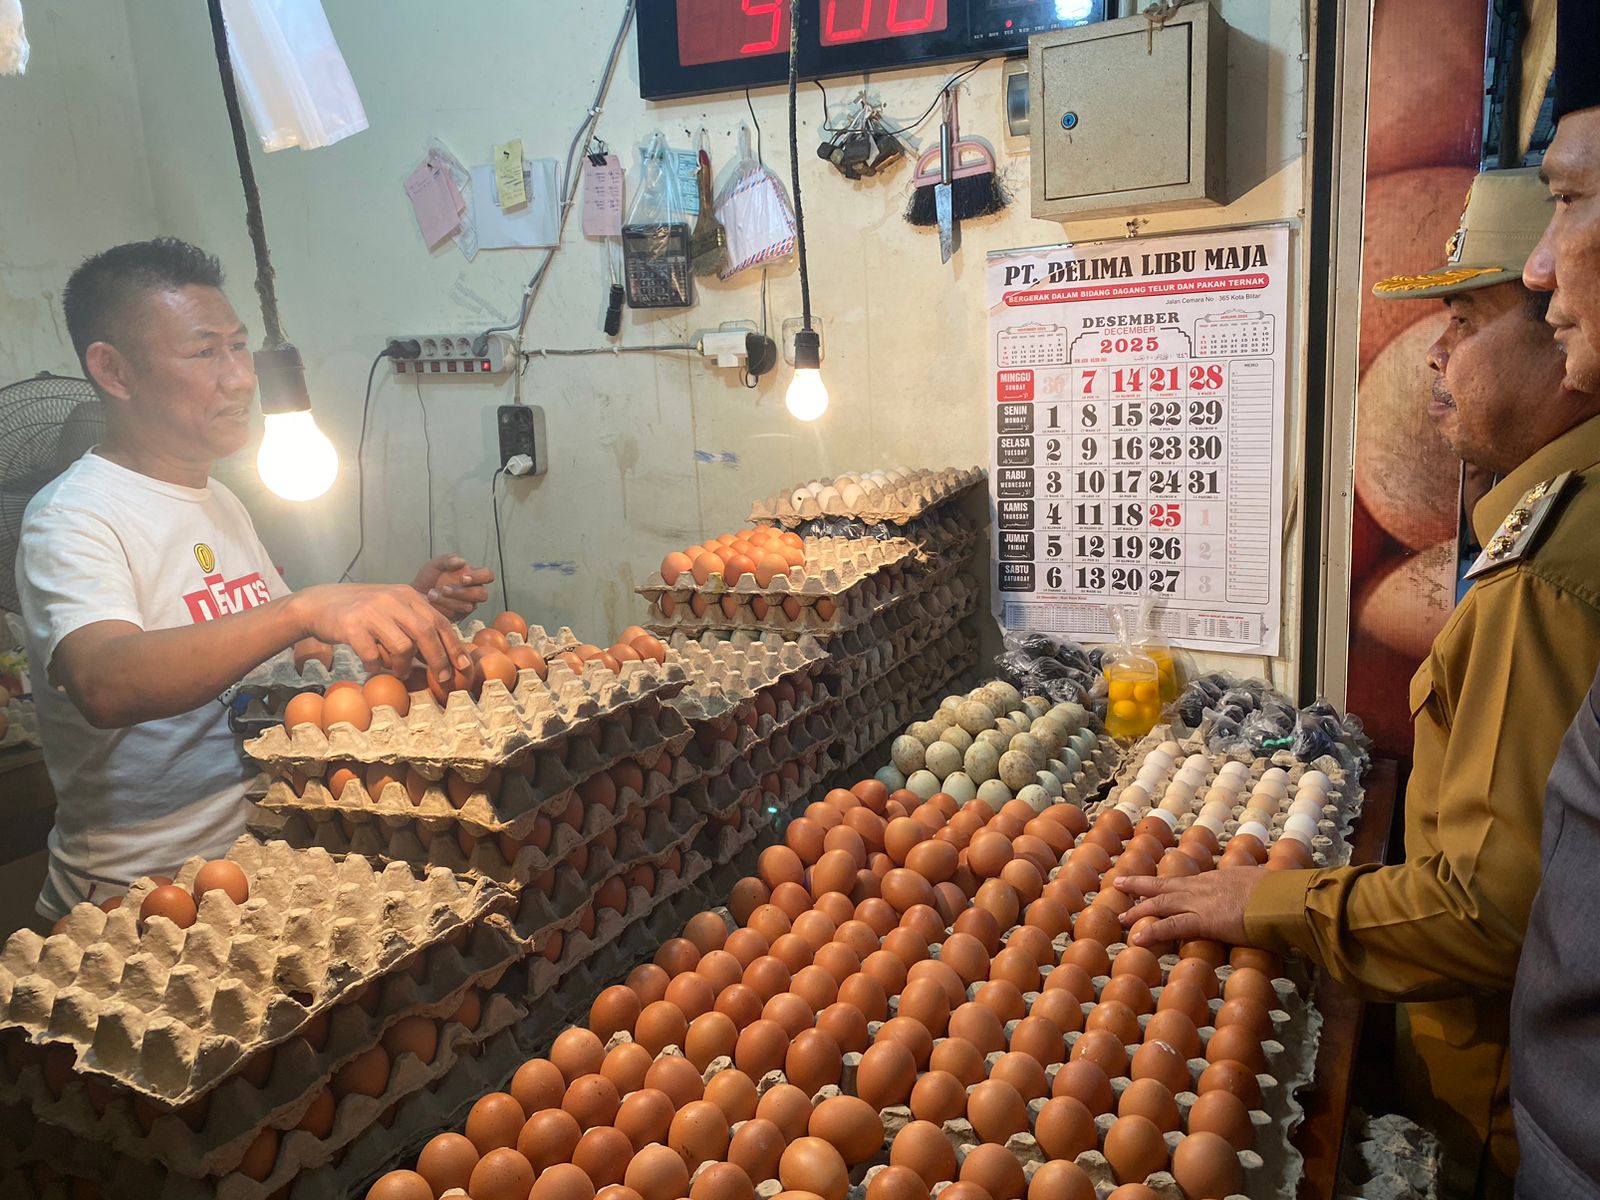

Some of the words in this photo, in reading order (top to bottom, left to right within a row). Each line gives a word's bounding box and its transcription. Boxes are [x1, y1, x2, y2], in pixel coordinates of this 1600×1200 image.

[1004, 264, 1040, 287] PT.
[1048, 256, 1133, 284] DELIMA
[1141, 250, 1196, 276] LIBU
[1205, 244, 1268, 271] MAJA
[1008, 293, 1049, 304] BERGERAK
[1051, 291, 1078, 301] DALAM
[1080, 289, 1110, 298] BIDANG
[1112, 286, 1146, 296] DAGANG
[1148, 284, 1175, 293] TELUR
[1177, 282, 1195, 291] DAN
[1197, 280, 1226, 289] PAKAN
[1229, 277, 1265, 287] TERNAK
[1082, 312, 1180, 328] DESEMBER
[1104, 325, 1155, 336] DECEMBER
[1100, 336, 1159, 353] 2025
[1000, 373, 1031, 383] MINGGU
[1081, 370, 1098, 394] 7
[1112, 368, 1143, 393] 14
[1149, 366, 1182, 391] 21
[1189, 364, 1223, 390] 28
[1005, 383, 1026, 391] SUNDAY
[1003, 405, 1028, 415] SENIN
[1047, 404, 1061, 428] 1
[1081, 403, 1098, 427] 8
[1112, 402, 1143, 426] 15
[1149, 401, 1182, 426] 22
[1189, 400, 1223, 426] 29
[1001, 438, 1030, 448] SELASA
[1047, 438, 1062, 461] 2
[1081, 437, 1098, 460] 9
[1112, 436, 1143, 460] 16
[1149, 435, 1182, 460] 23
[1188, 435, 1222, 460] 30
[1005, 470, 1026, 480] RABU
[1046, 470, 1062, 494] 3
[1074, 470, 1105, 493] 10
[1112, 470, 1142, 493] 17
[1149, 469, 1182, 493] 24
[1188, 470, 1221, 494] 31
[1003, 502, 1028, 512] KAMIS
[1046, 502, 1062, 525] 4
[1074, 502, 1104, 525] 11
[1112, 503, 1143, 526] 18
[1149, 503, 1182, 527] 25
[1200, 508, 1211, 528] 1
[1004, 534, 1029, 543] JUMAT
[1046, 534, 1062, 557] 5
[1074, 534, 1105, 558] 12
[1112, 535, 1143, 559] 19
[1149, 536, 1182, 560] 26
[1200, 542, 1211, 560] 2
[1005, 565, 1029, 574] SABTU
[1046, 566, 1062, 589] 6
[1075, 566, 1106, 589] 13
[1111, 568, 1143, 591] 20
[1149, 569, 1181, 592] 27
[1199, 575, 1211, 593] 3
